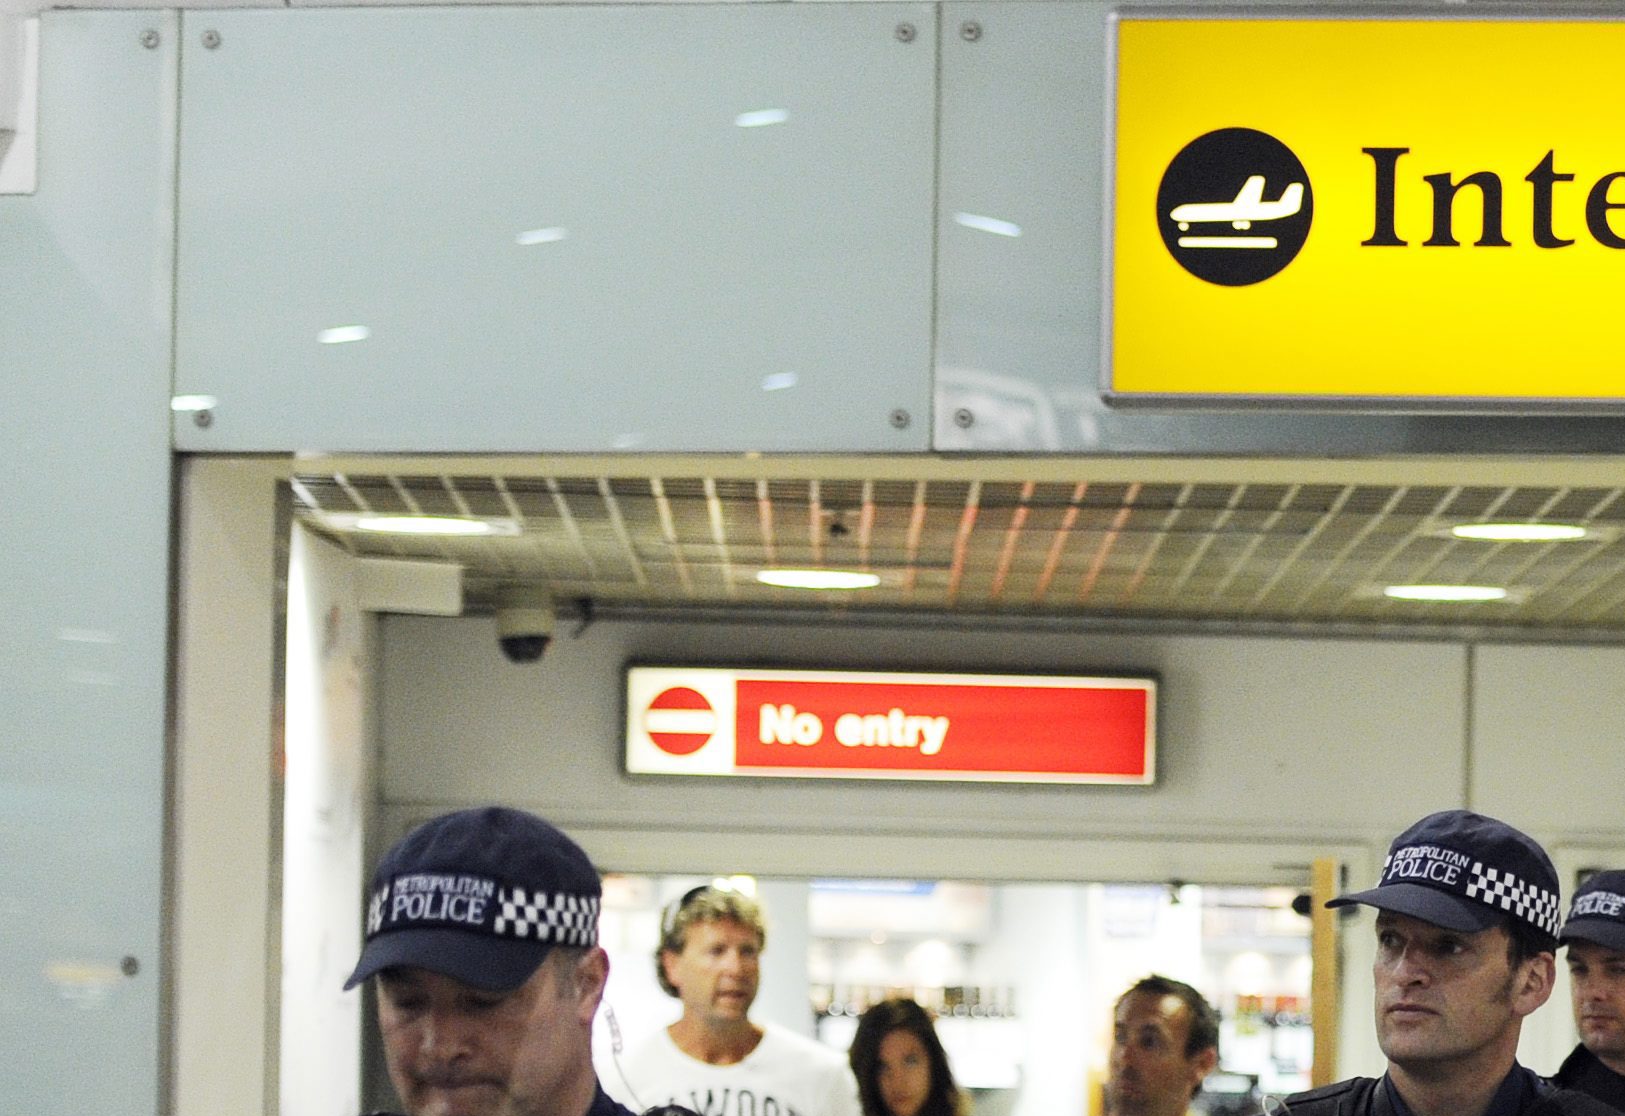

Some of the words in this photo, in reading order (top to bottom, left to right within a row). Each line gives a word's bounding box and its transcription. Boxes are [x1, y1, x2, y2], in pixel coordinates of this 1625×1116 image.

[759, 703, 823, 746] No
[834, 708, 949, 755] entry
[1387, 858, 1461, 885] POLICE
[1394, 845, 1470, 869] METROPOLITAN
[391, 893, 486, 924] POLICE
